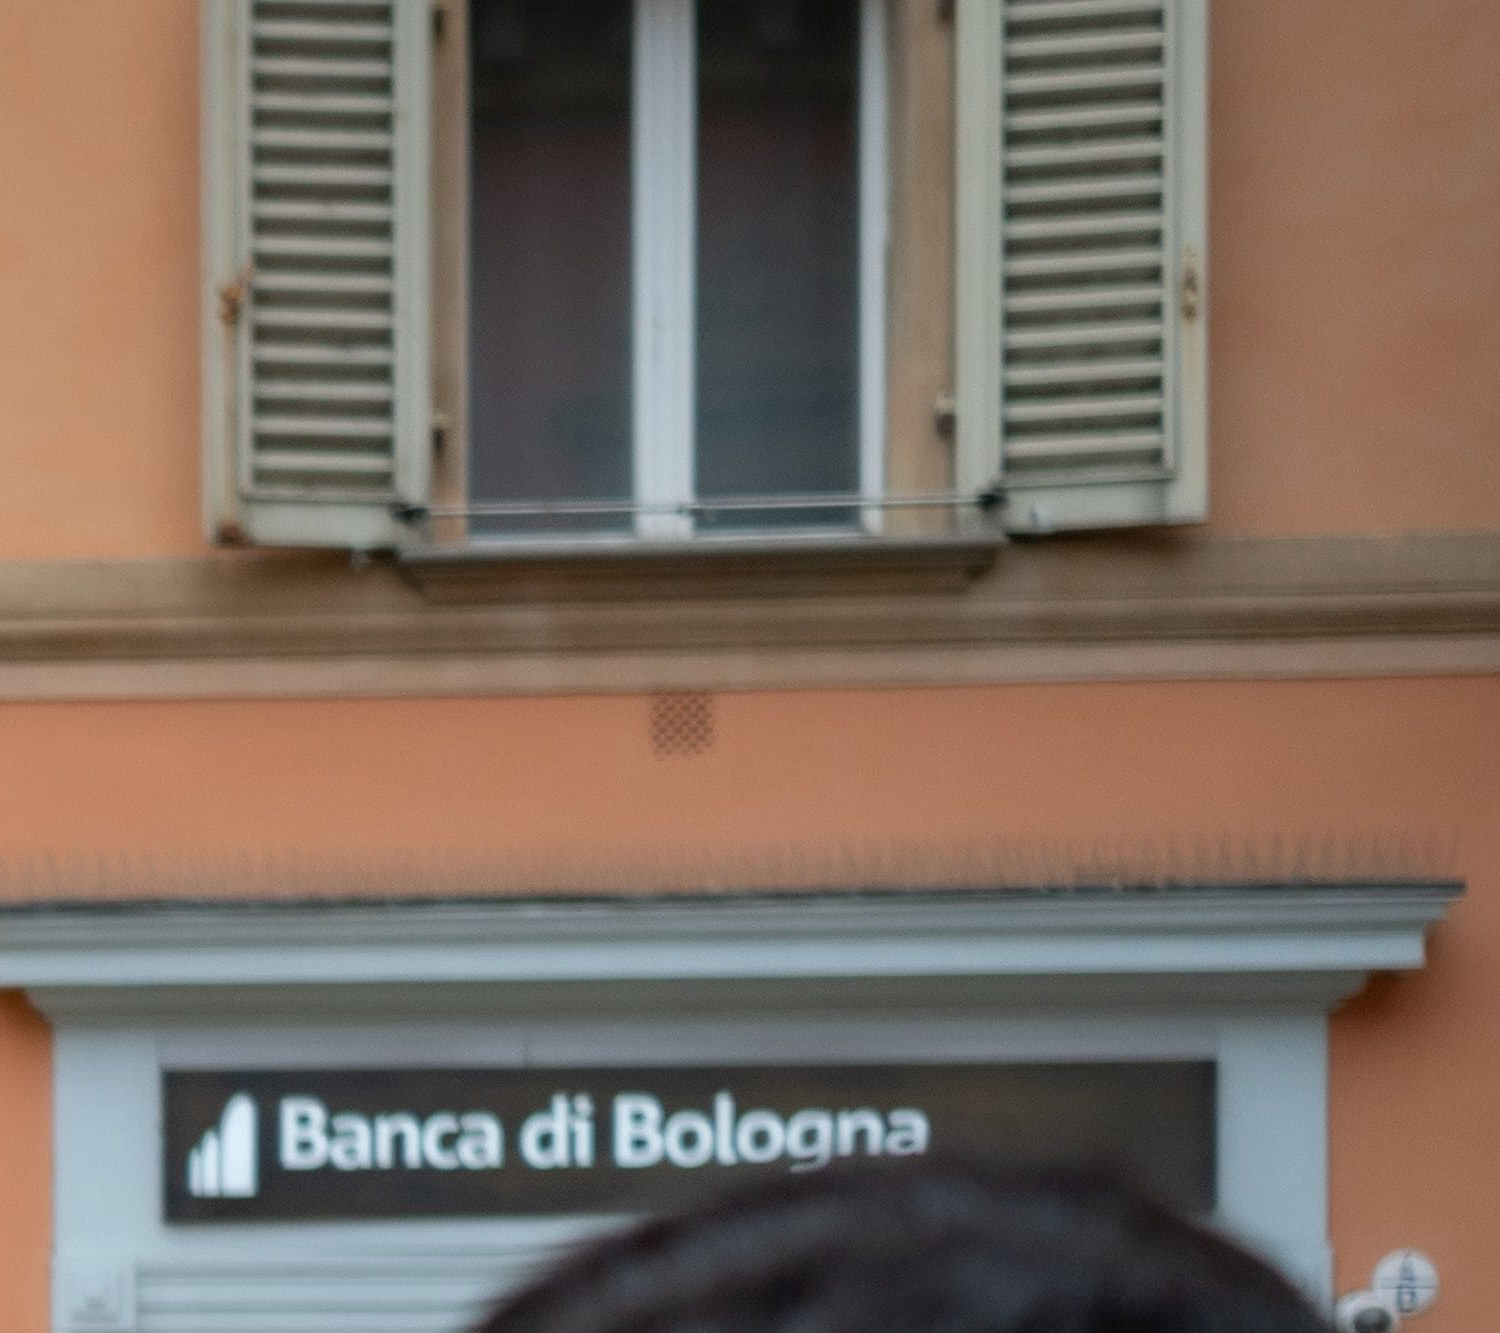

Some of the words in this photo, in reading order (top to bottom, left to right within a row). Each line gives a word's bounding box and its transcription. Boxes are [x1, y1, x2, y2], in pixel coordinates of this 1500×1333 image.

[279, 1096, 505, 1171] Banca
[519, 1092, 595, 1170] di
[612, 1090, 931, 1174] Bologna
